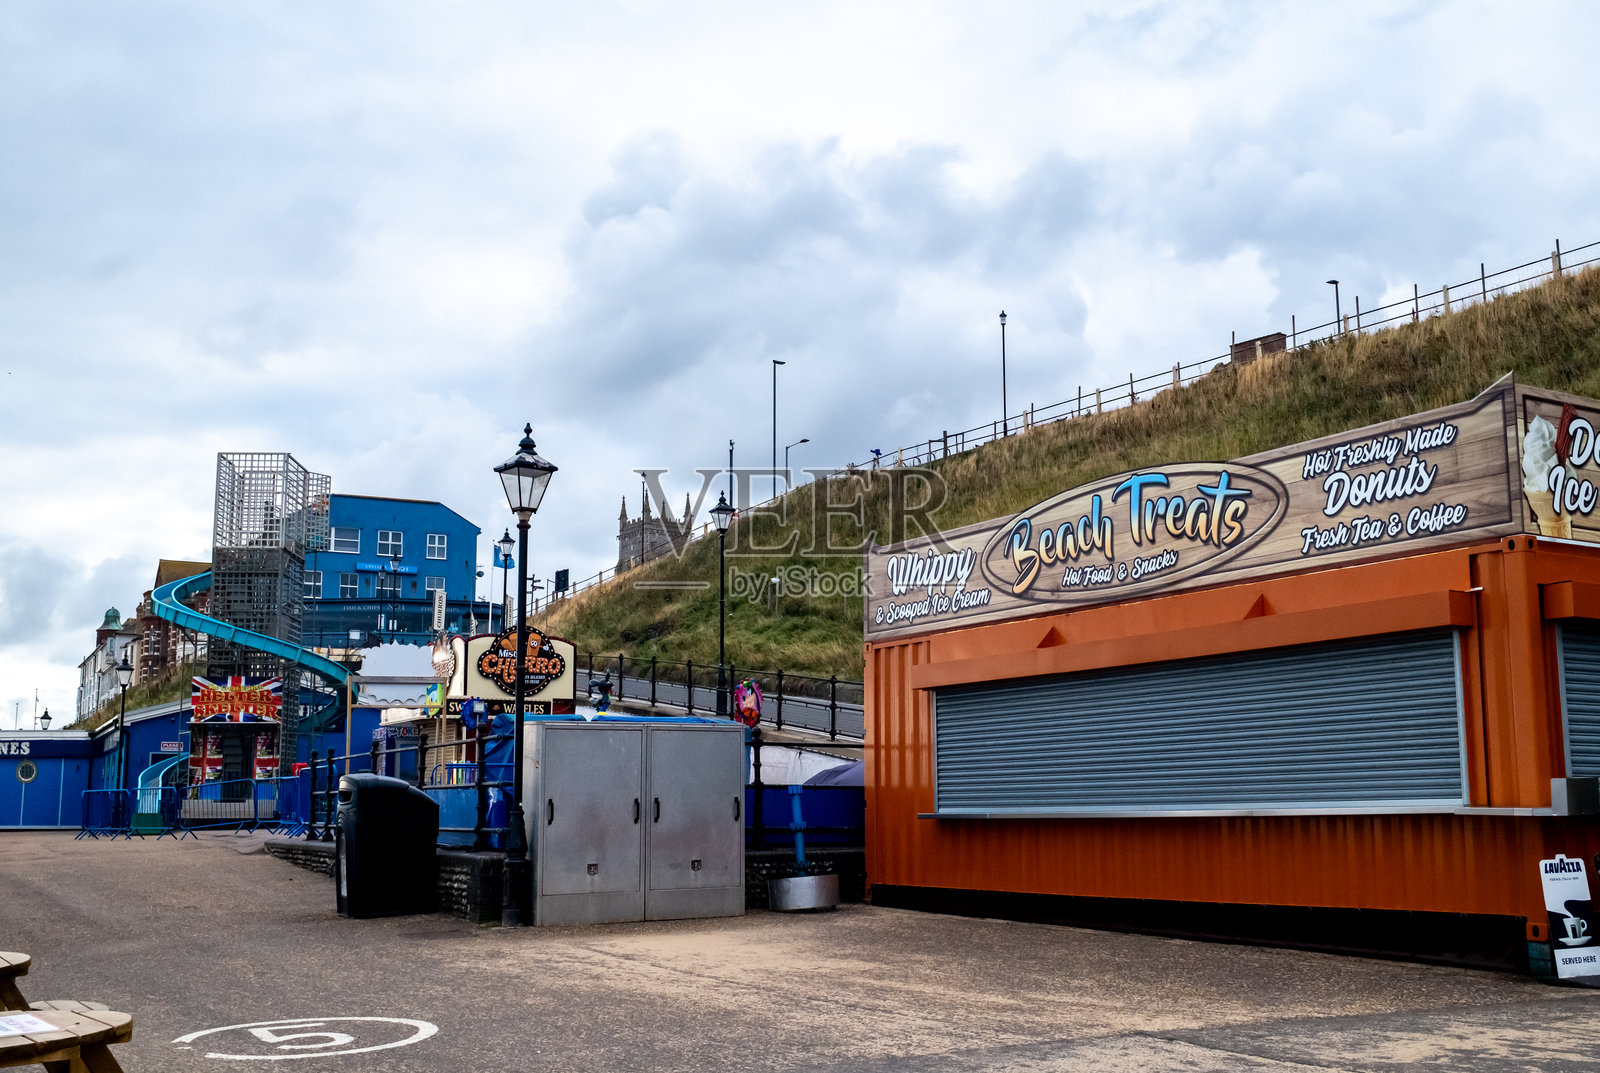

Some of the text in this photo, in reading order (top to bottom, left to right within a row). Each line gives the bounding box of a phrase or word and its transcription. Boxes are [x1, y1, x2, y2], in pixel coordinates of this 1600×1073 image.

[1303, 422, 1458, 478] Hot Freshly Made
[1323, 457, 1437, 517] Donuts
[1548, 465, 1599, 514] Ice
[1004, 470, 1253, 595] Beach Treats
[1302, 504, 1467, 554] Fresh Tea & Coffee
[887, 547, 977, 596] Whippy
[1063, 550, 1179, 587] Hot Food & Snacks
[436, 595, 444, 629] CHURROS
[876, 588, 992, 624] & Scooped Ice Cream
[498, 648, 517, 658] Mist
[193, 704, 280, 721] SKELTER
[200, 688, 273, 704] HELTER
[503, 703, 545, 714] WAFLES
[1544, 857, 1583, 874] LAVAZZA
[1561, 955, 1597, 965] SERVED HERE
[249, 1022, 356, 1050] 5
